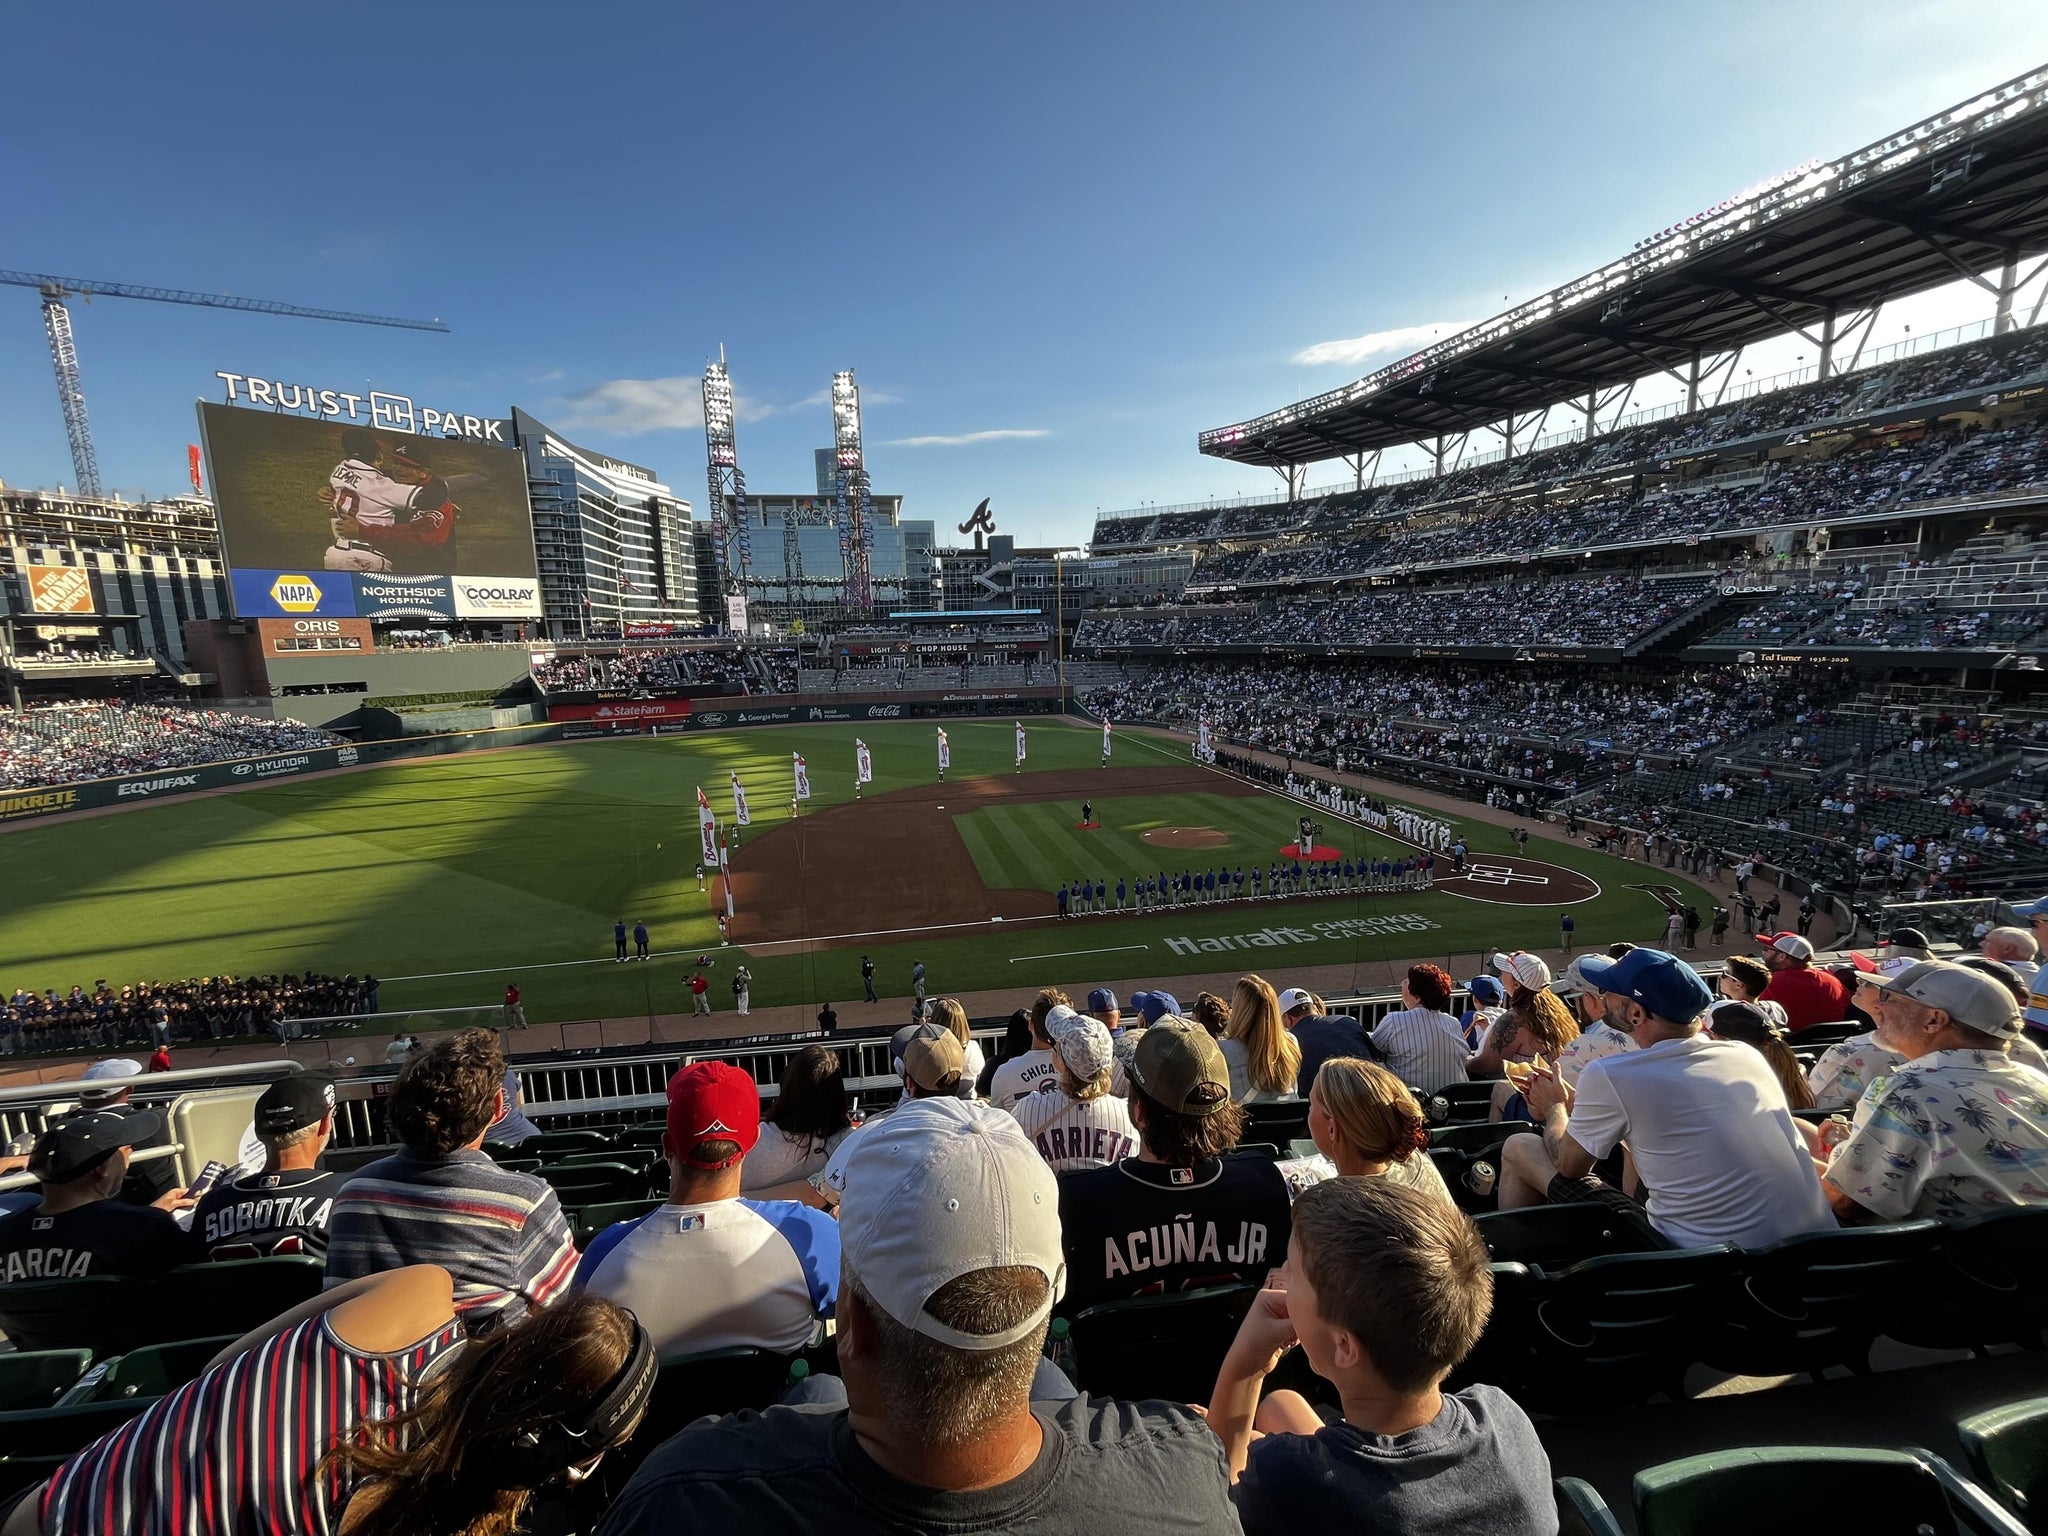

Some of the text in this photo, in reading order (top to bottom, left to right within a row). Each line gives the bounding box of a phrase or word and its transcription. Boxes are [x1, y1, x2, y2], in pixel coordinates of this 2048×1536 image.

[216, 371, 504, 442] TRUIST PARK
[781, 509, 838, 521] COMCAS
[35, 567, 88, 611] HOME
[279, 585, 315, 602] NAPA
[362, 586, 447, 597] NORTHSIDE
[466, 588, 535, 600] COOLRAY
[1736, 585, 1778, 593] LEXUS
[379, 597, 434, 605] HOSPITAL
[294, 620, 340, 632] ORIS
[627, 626, 667, 635] RaceTrac
[870, 646, 891, 654] LIGHT
[940, 644, 968, 652] HOUSE
[1760, 653, 1775, 662] Ted
[1776, 653, 1802, 662] Turner
[614, 705, 666, 716] State Farm
[748, 712, 789, 721] Georgia Power
[702, 713, 722, 723] Ford
[338, 747, 358, 756] PAPA
[256, 756, 309, 772] HYUNDAI
[118, 775, 197, 796] EQUIFAX
[703, 824, 717, 862] Braves
[1312, 913, 1428, 932] CHEROKEE
[1323, 920, 1443, 940] CASINOS
[1163, 926, 1320, 956] Harrah's
[1020, 1063, 1057, 1083] CHICA
[1037, 1126, 1132, 1160] ARRIETA
[205, 1197, 334, 1244] SOBOTKA
[1105, 1213, 1268, 1279] ACUÑA JR
